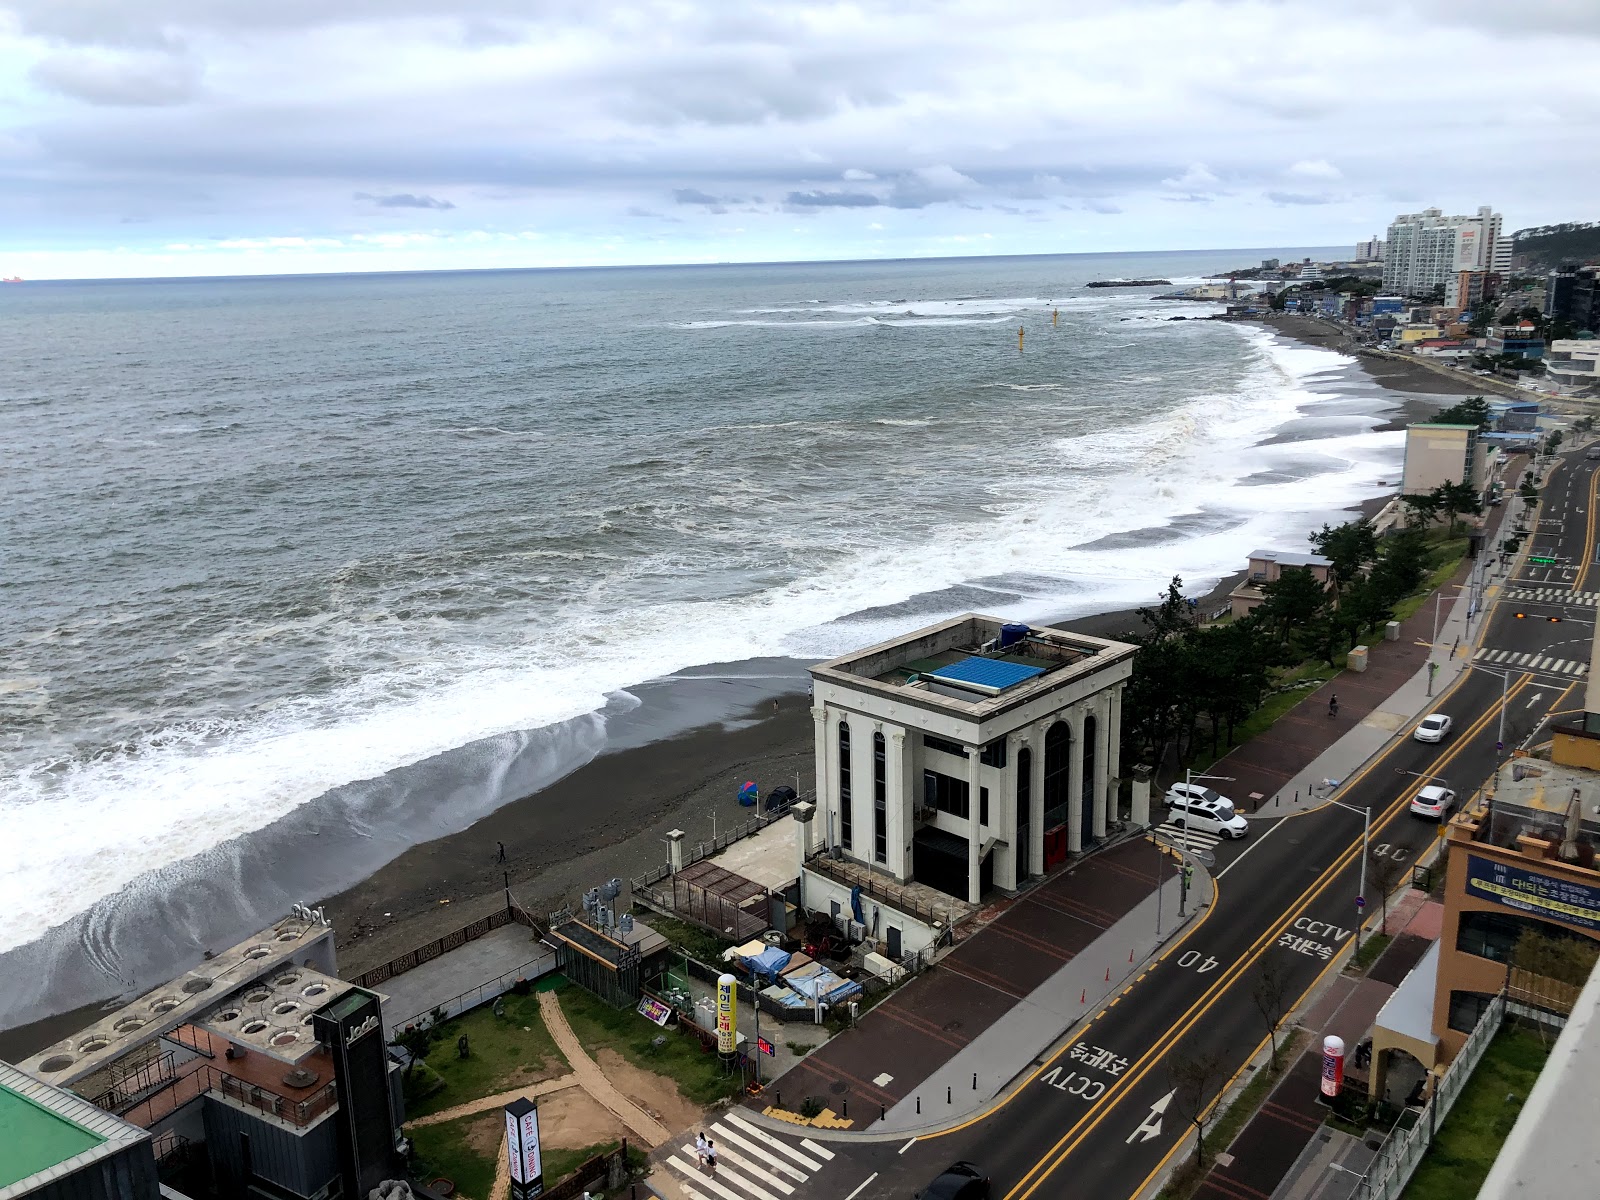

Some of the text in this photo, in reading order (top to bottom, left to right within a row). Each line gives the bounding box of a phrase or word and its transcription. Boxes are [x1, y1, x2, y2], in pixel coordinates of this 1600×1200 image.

[1293, 917, 1351, 942] CCTV
[1278, 932, 1334, 960] 주차단속
[1177, 950, 1220, 973] 40
[346, 1015, 379, 1042] Jade
[1070, 1041, 1129, 1076] 주차단속
[1040, 1066, 1106, 1100] CCTV
[512, 1152, 520, 1179] DINING
[527, 1151, 537, 1178] DINING
